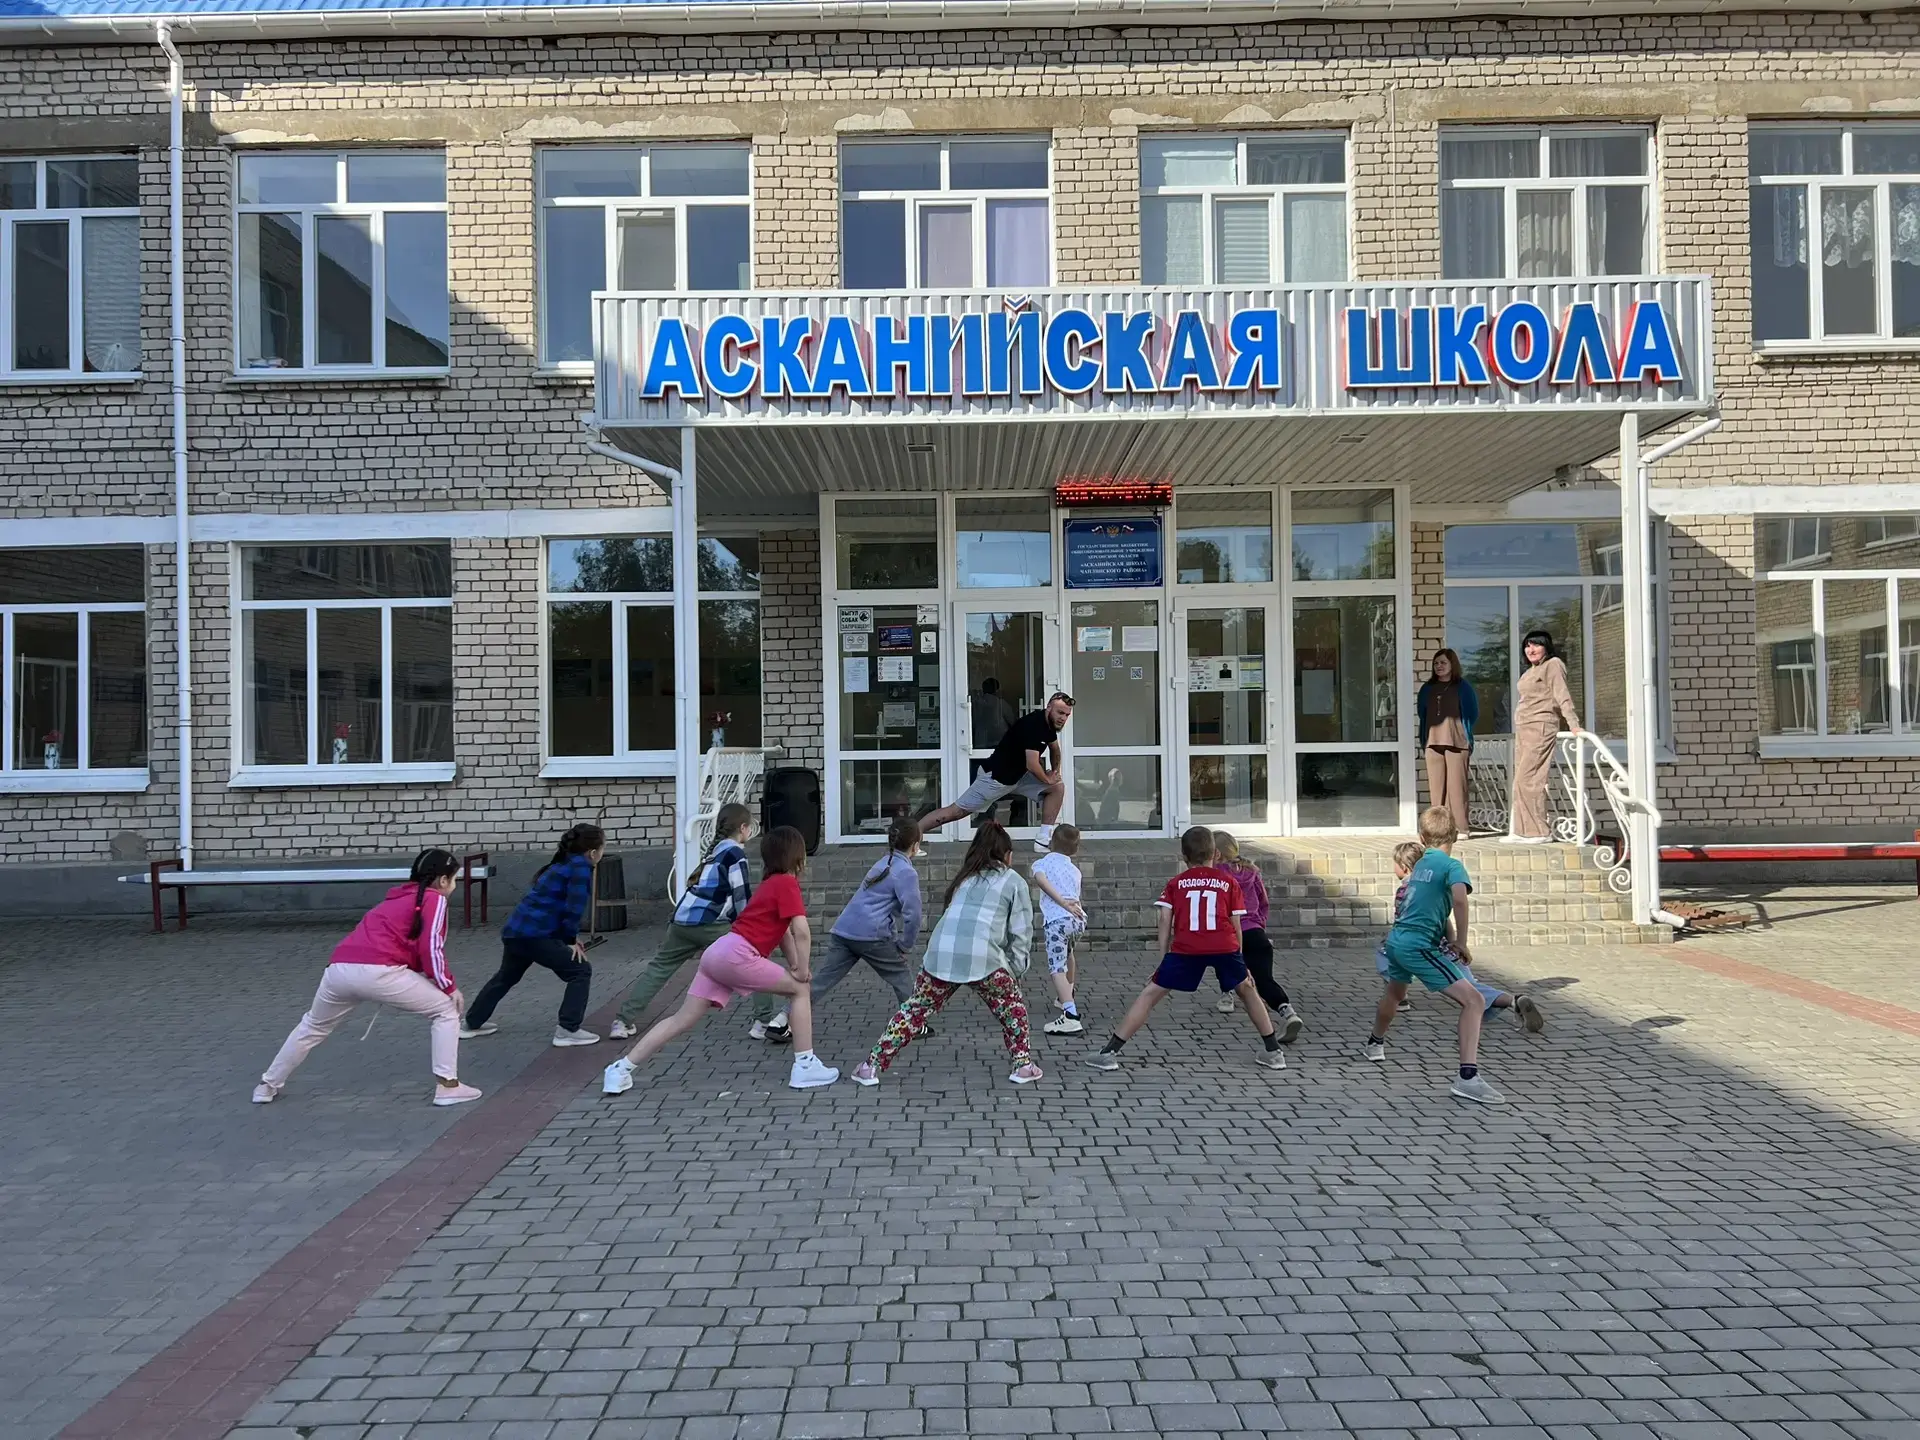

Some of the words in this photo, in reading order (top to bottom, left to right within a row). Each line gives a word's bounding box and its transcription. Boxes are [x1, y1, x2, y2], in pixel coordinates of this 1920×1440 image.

[640, 294, 1282, 399] АСКАНИЙСКАЯ
[1343, 301, 1683, 389] ШКОЛА
[1178, 878, 1230, 893] РОЗДОБУДЬКО
[1185, 890, 1217, 931] 11
